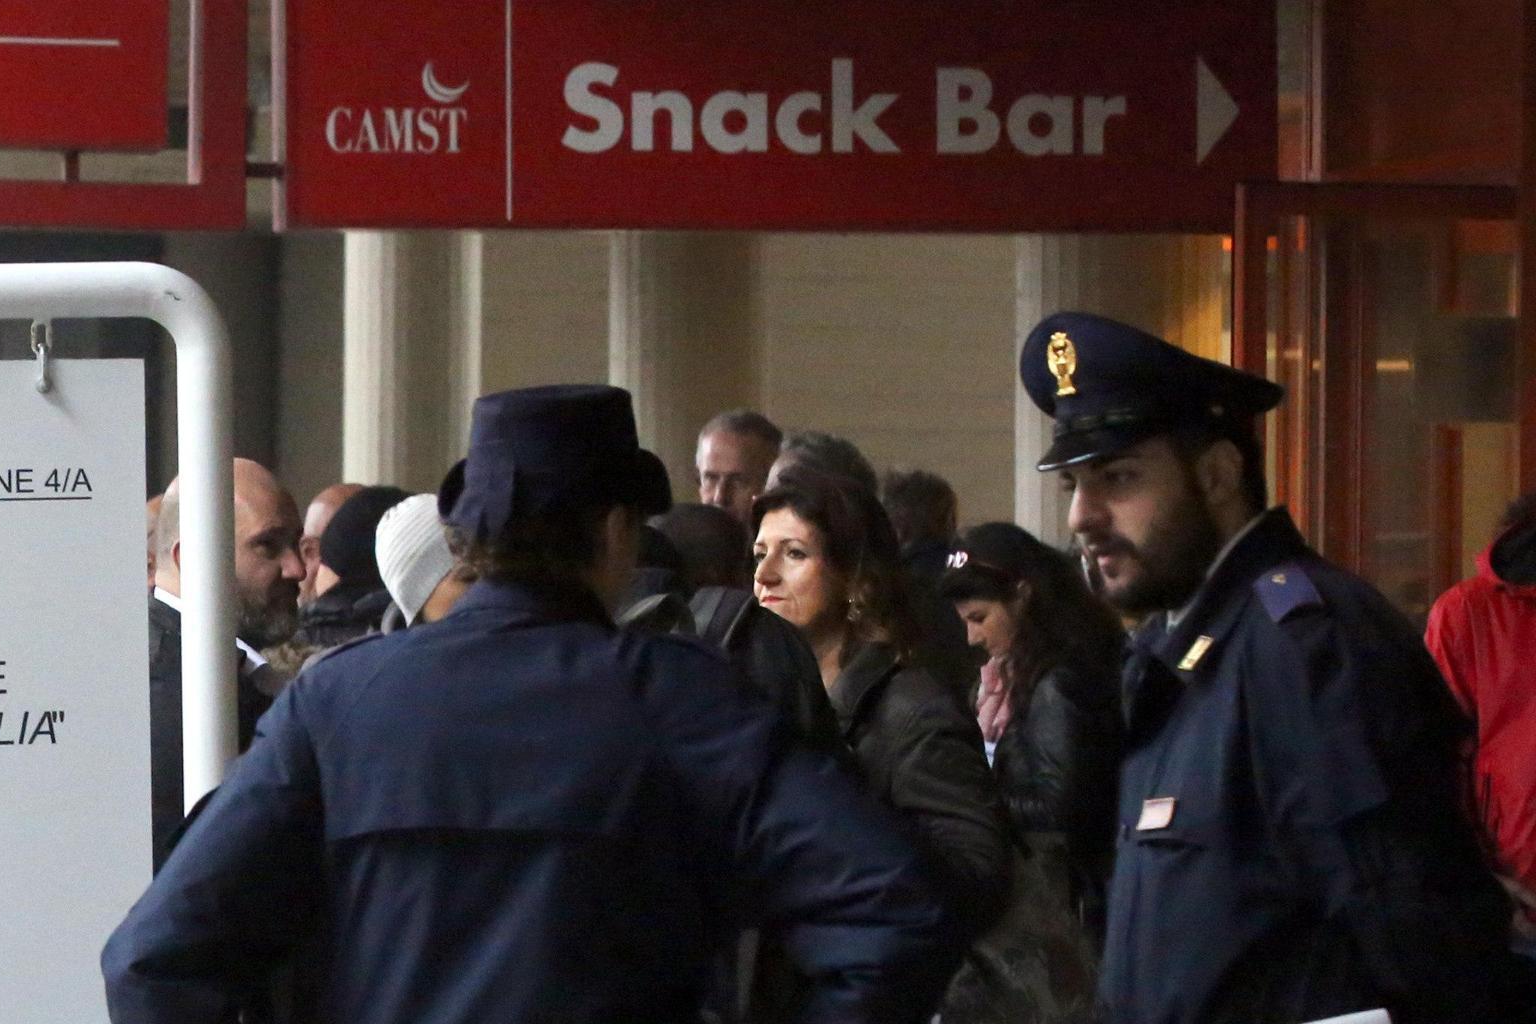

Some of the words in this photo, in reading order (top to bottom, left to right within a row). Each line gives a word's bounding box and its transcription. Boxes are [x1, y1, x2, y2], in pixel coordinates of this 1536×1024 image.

[325, 106, 468, 153] CAMST
[560, 58, 901, 154] Snack
[935, 66, 1127, 156] Bar
[44, 467, 93, 493] 4/A
